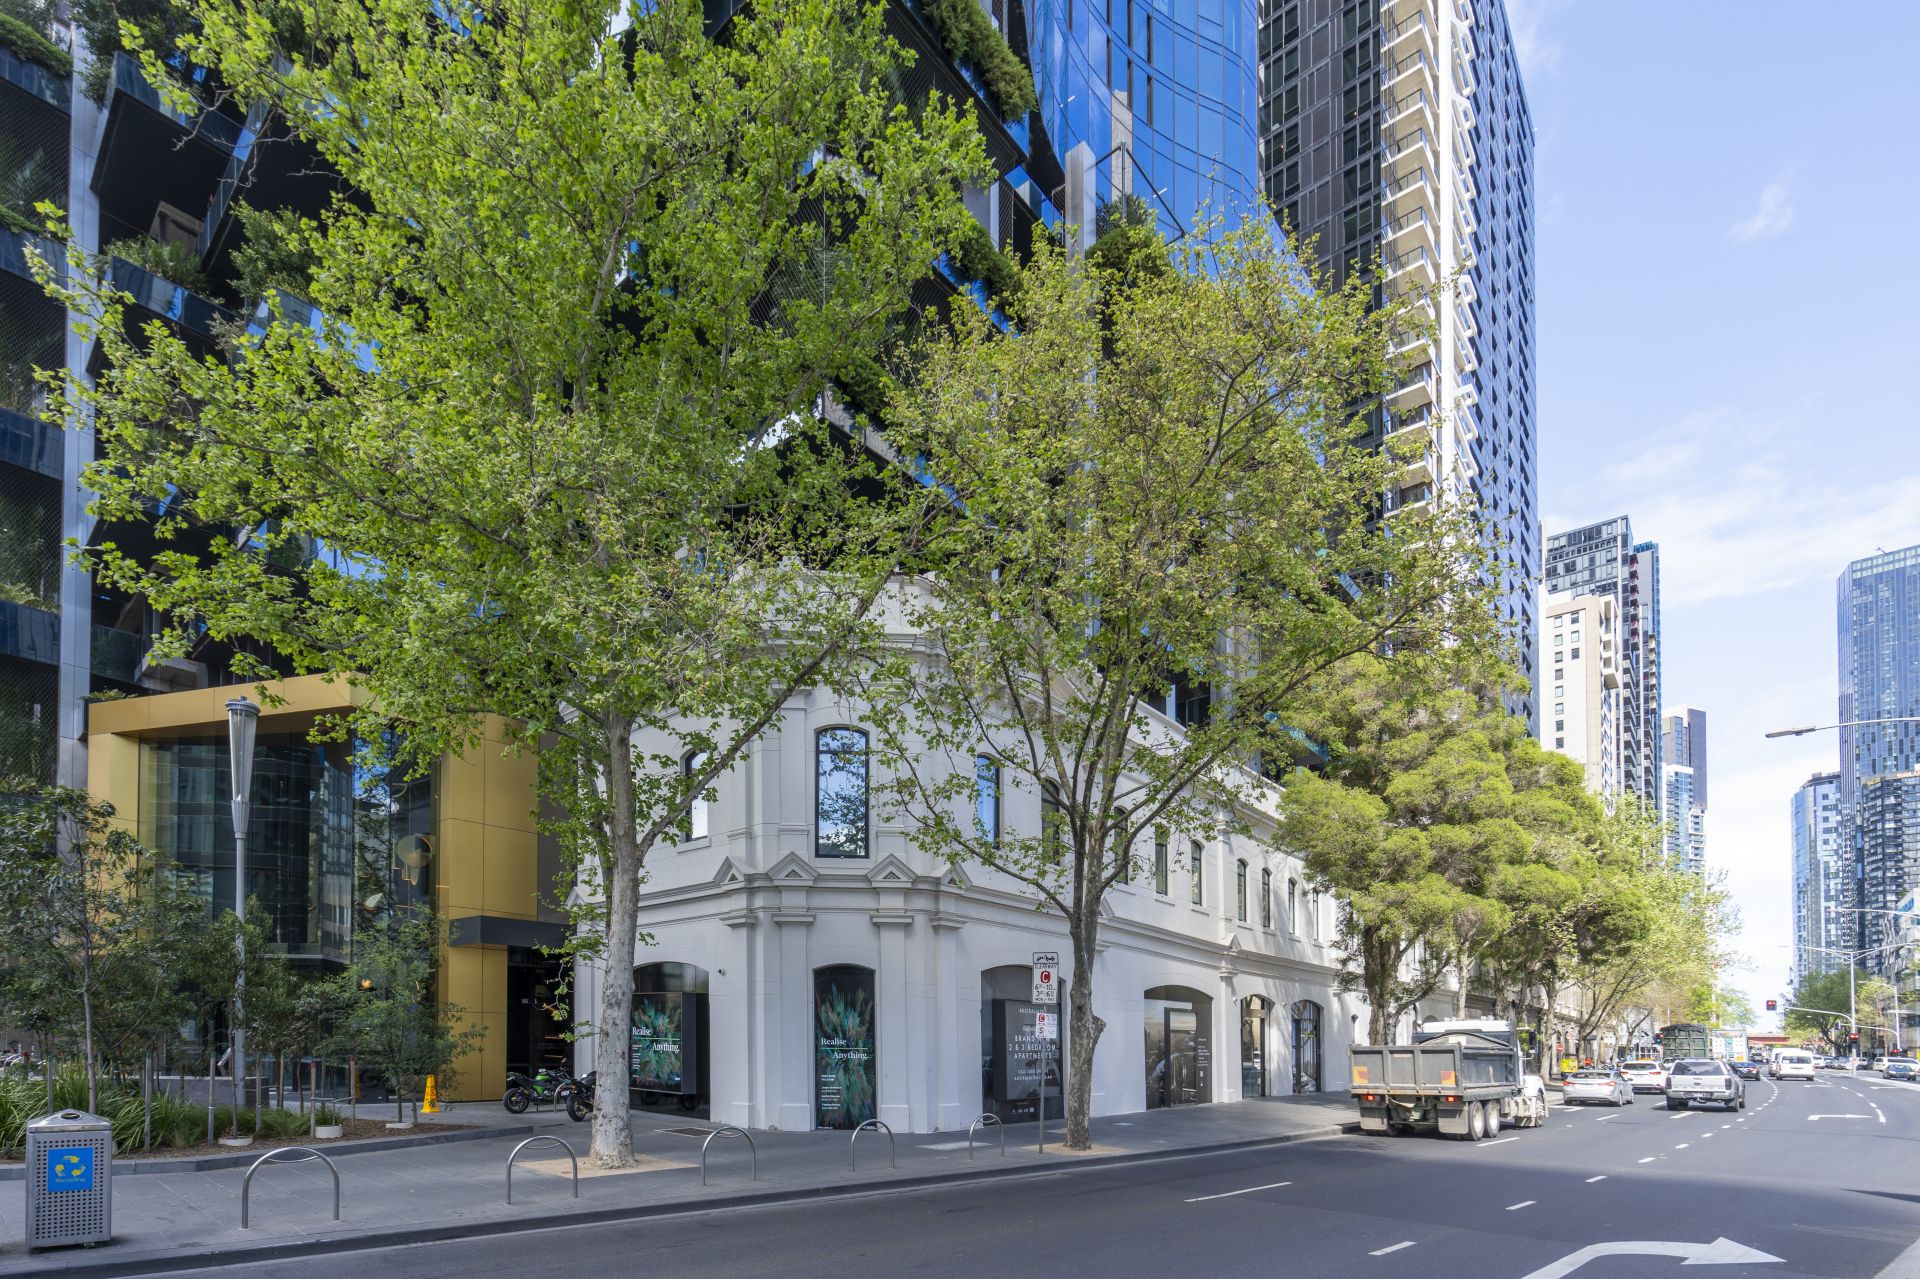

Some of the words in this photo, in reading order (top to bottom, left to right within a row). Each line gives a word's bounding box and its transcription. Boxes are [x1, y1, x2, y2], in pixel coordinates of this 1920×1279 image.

[632, 1026, 651, 1035] Realise
[821, 1037, 847, 1045] Realise
[652, 1041, 680, 1054] Anything.
[1008, 1043, 1012, 1051] 2
[1027, 1043, 1056, 1051] BEDROM
[833, 1051, 869, 1060] Anything.
[1013, 1052, 1052, 1060] APARTMETS
